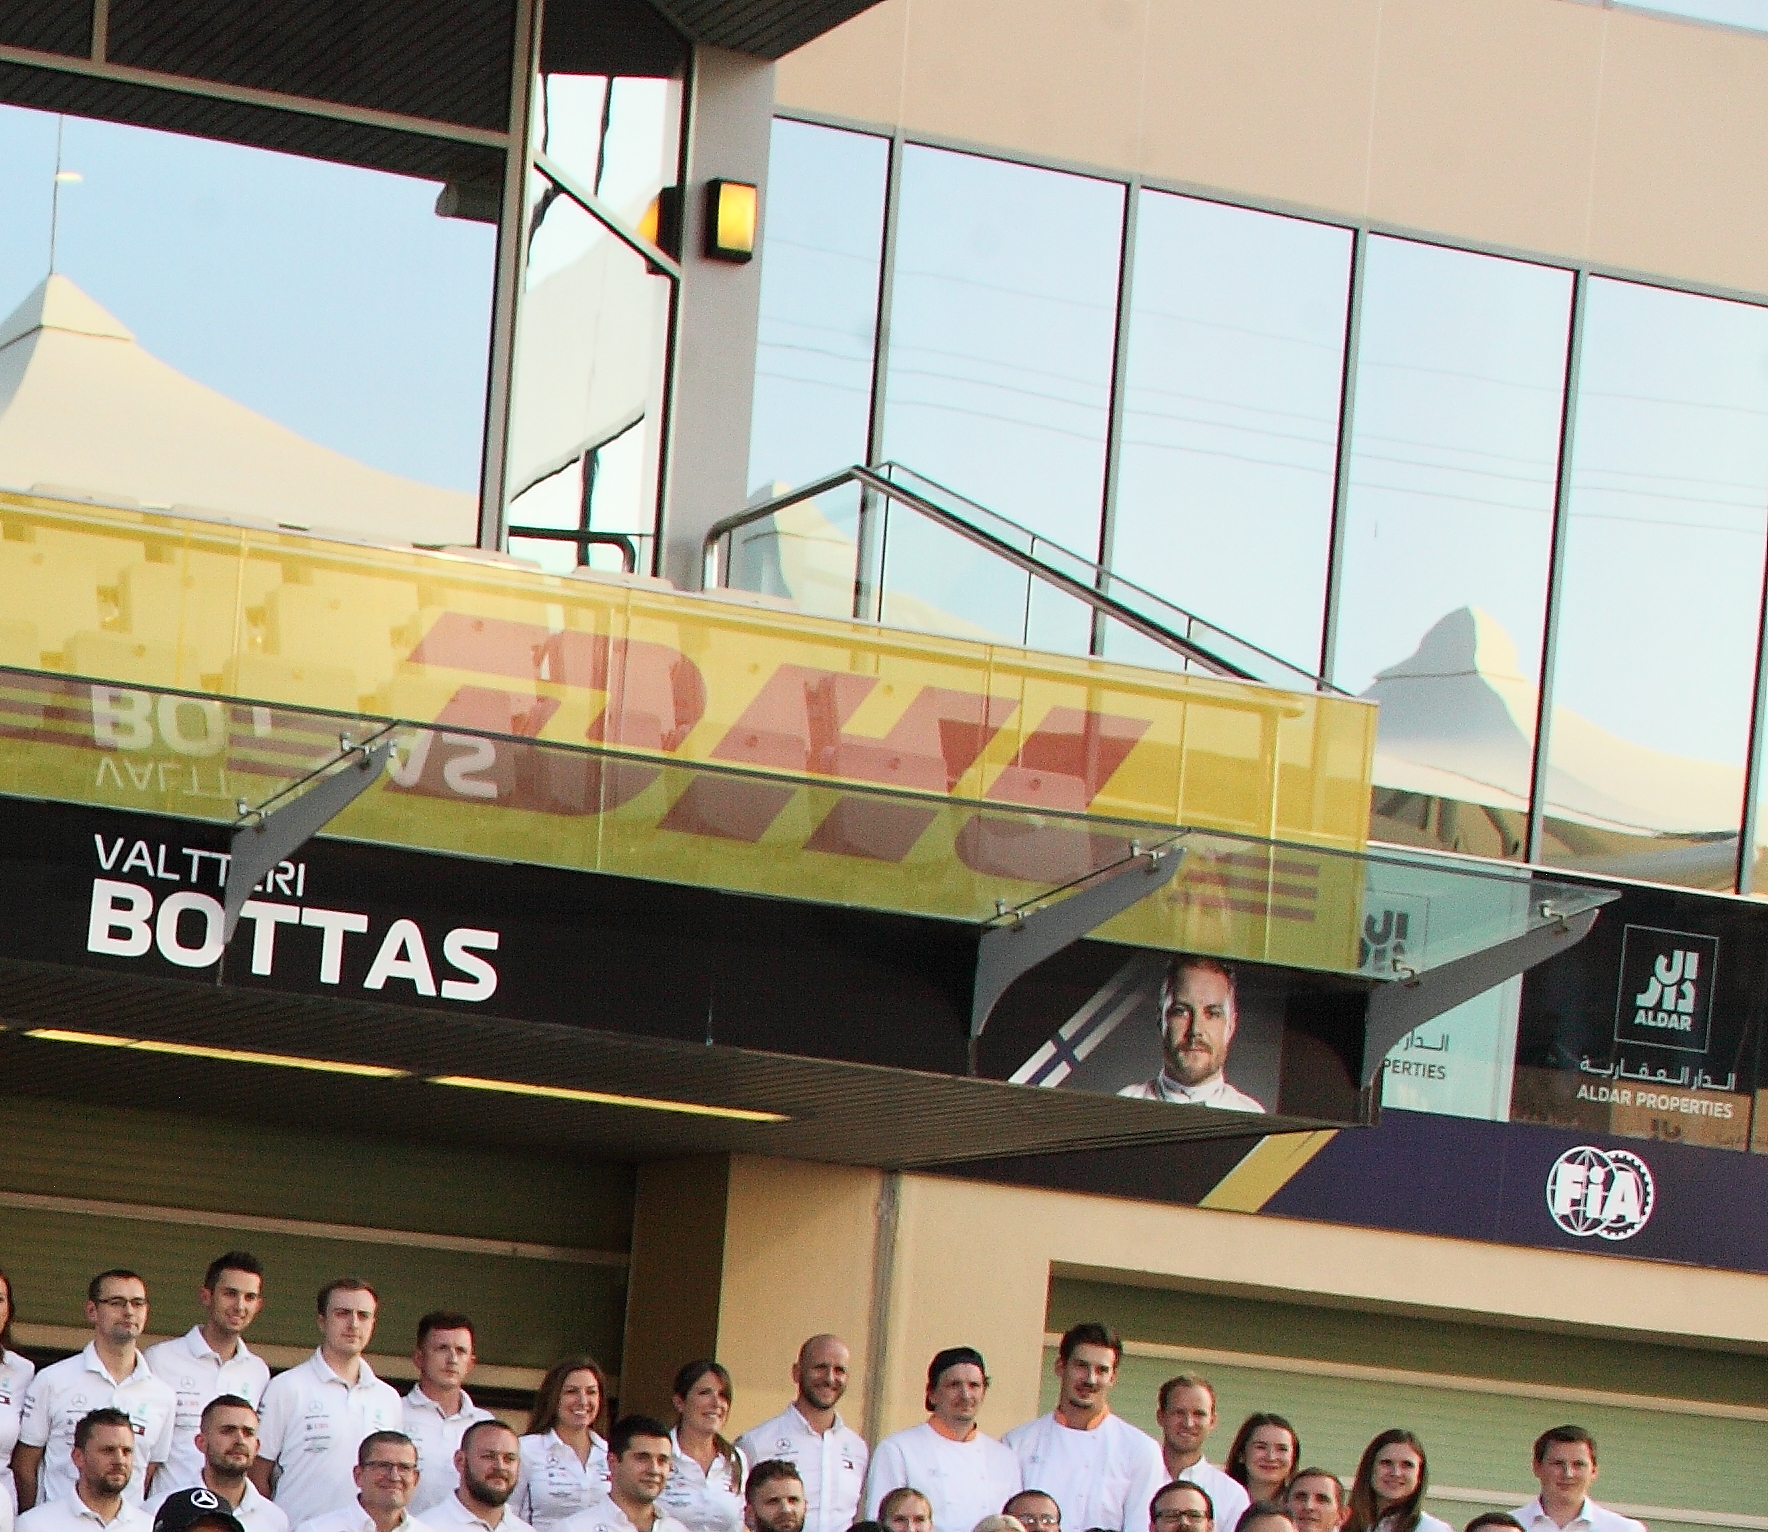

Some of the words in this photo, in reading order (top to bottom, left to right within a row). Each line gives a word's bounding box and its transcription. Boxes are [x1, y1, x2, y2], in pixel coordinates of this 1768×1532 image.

[382, 612, 1164, 888] DHL
[93, 833, 306, 898] VALTTRI
[86, 878, 500, 1003] BOTTAS
[1633, 1008, 1693, 1033] ALDAR
[1383, 1059, 1446, 1082] PERTIES
[1576, 1083, 1632, 1107] ALDAR
[1635, 1090, 1734, 1120] PROPERTIES
